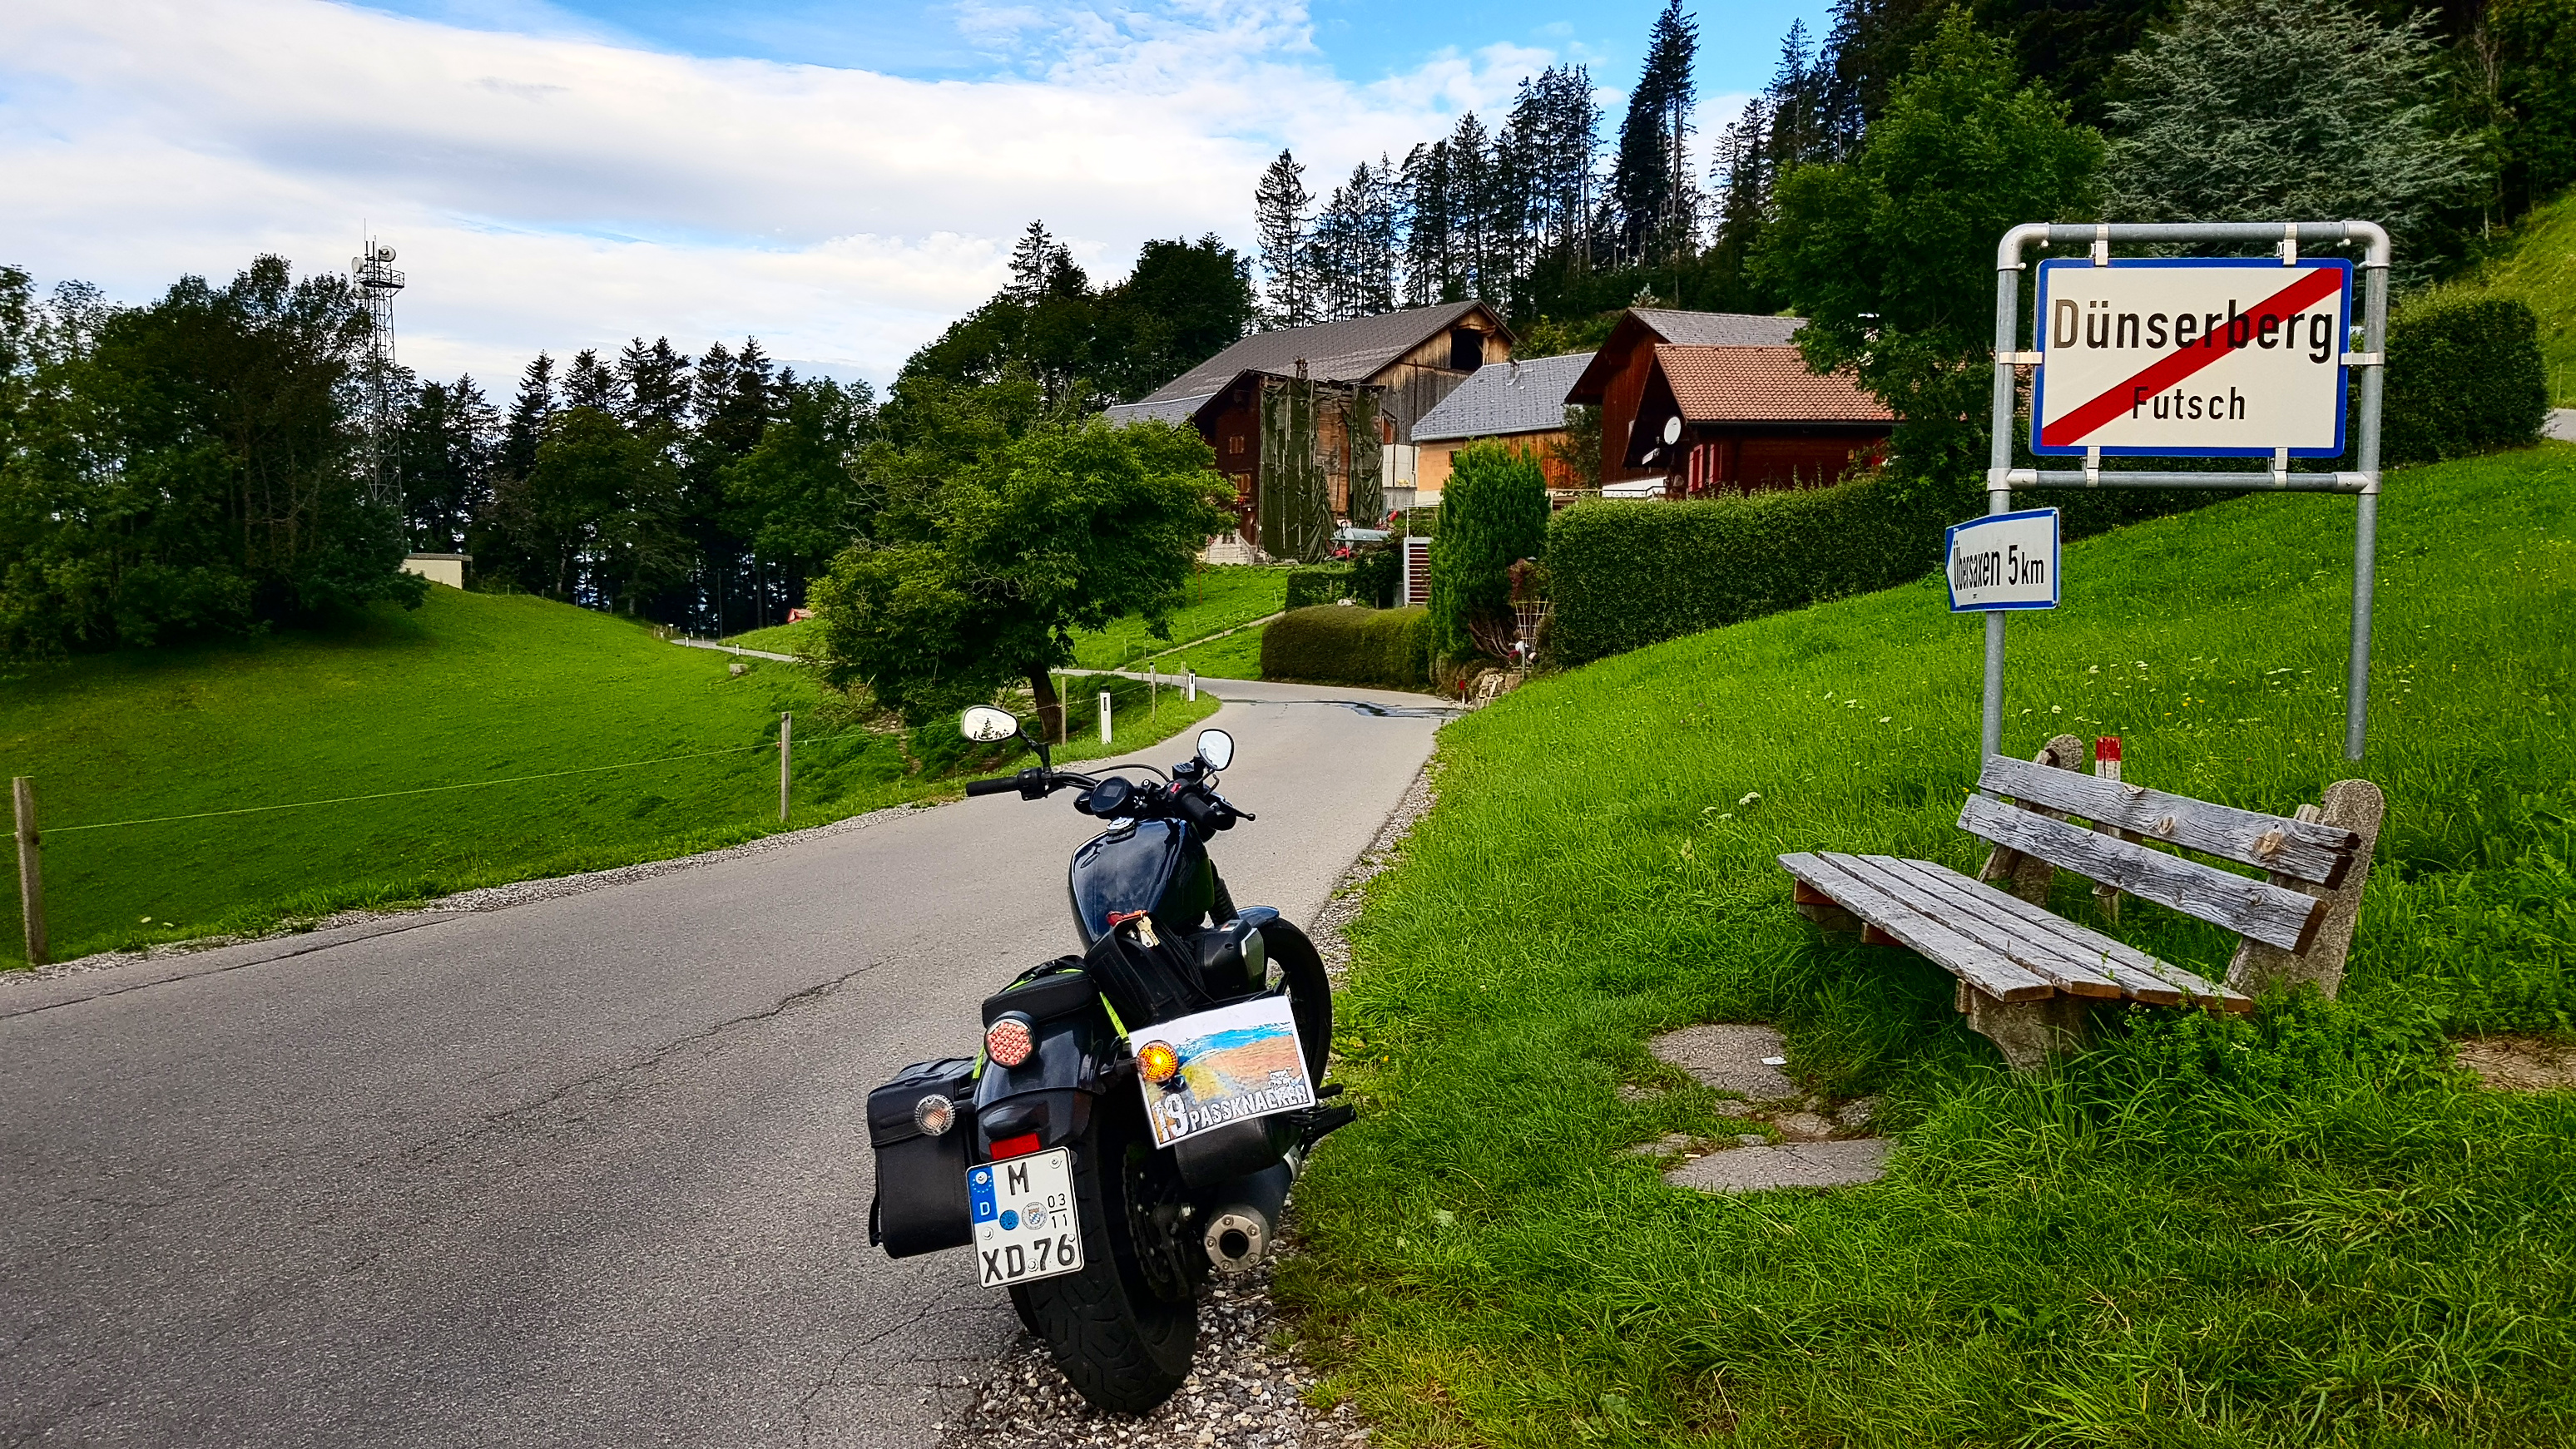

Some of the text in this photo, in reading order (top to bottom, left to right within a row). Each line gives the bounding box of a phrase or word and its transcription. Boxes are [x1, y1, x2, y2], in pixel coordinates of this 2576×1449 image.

[2053, 299, 2333, 364] Dünserberg
[2133, 386, 2246, 420] Futsch
[1953, 540, 2044, 591] Übersaxen 5 km
[1189, 1085, 1309, 1131] PASSKNACKER
[1008, 1161, 1030, 1196] M
[979, 1201, 991, 1216] D
[1047, 1193, 1066, 1209] 03
[1051, 1214, 1068, 1229] 11
